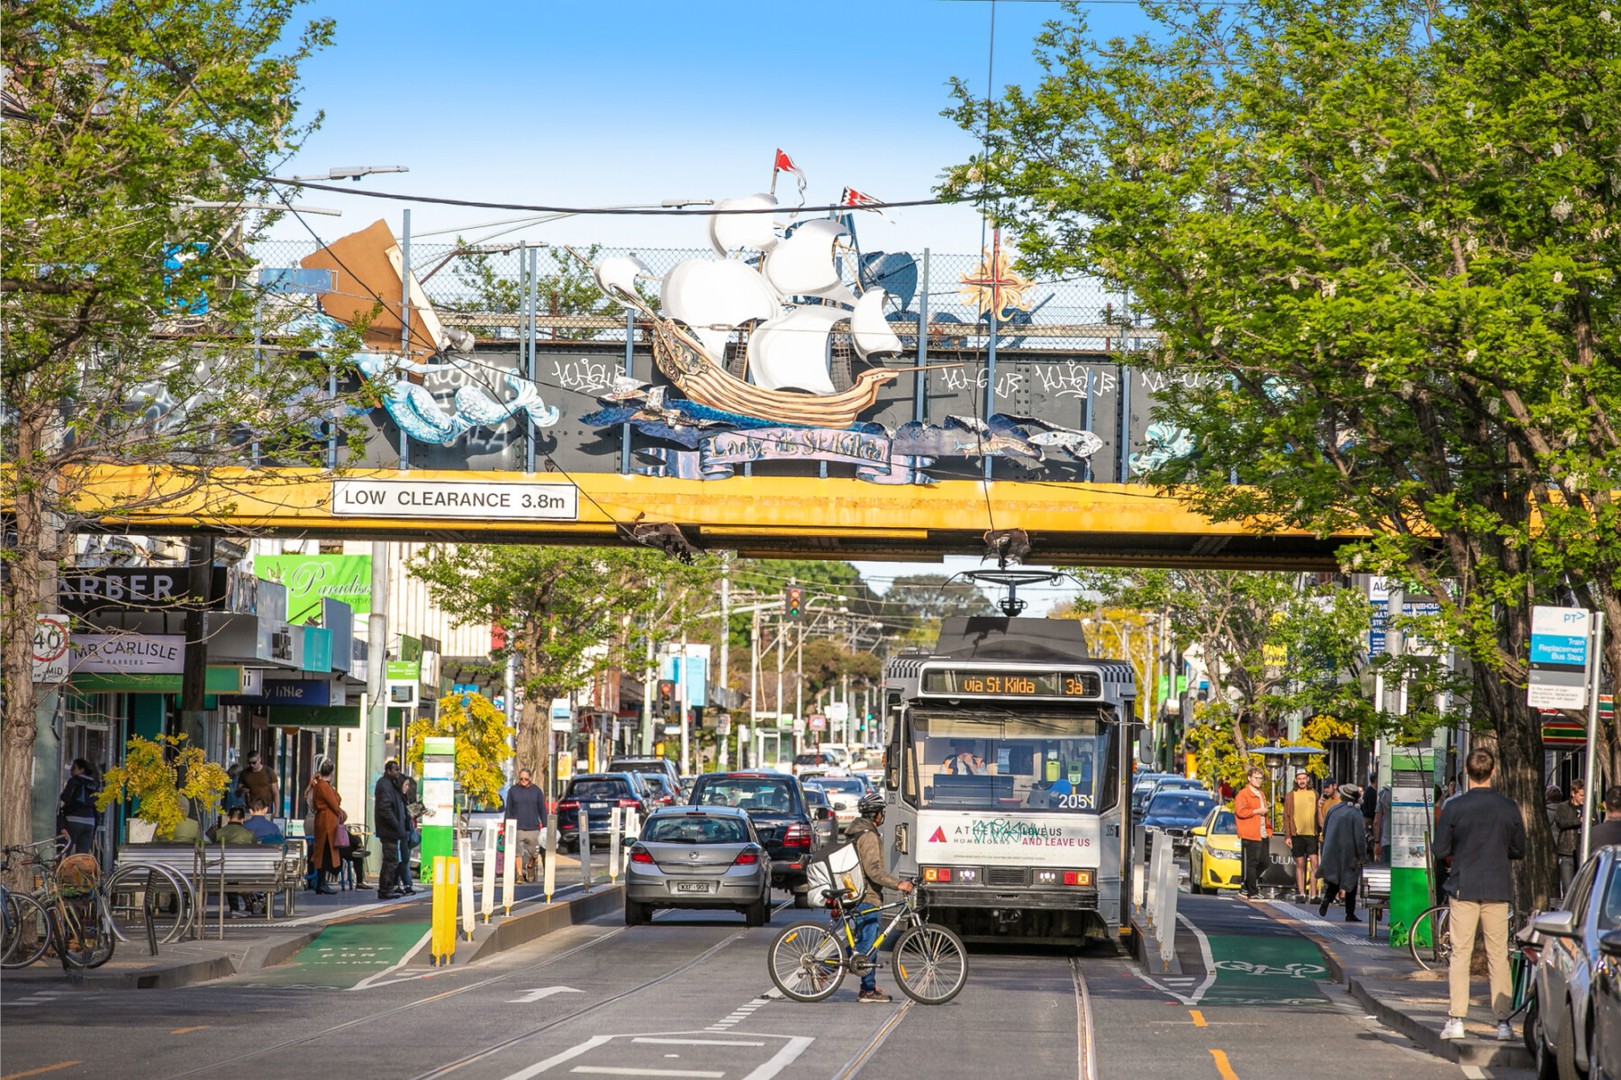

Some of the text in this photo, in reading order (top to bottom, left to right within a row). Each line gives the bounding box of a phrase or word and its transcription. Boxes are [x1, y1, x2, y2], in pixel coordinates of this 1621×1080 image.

[345, 490, 565, 508] LOW CLEARANCE 3.8m
[59, 575, 173, 600] ARBER
[34, 631, 60, 649] 40
[103, 642, 178, 660] CARLISLE
[1538, 644, 1584, 653] Replacement
[1551, 652, 1565, 660] Bus
[964, 677, 1083, 695] via St Kilda 3a
[1058, 794, 1096, 809] 2051
[1049, 828, 1062, 836] US
[1022, 837, 1090, 847] AND LEAVE US
